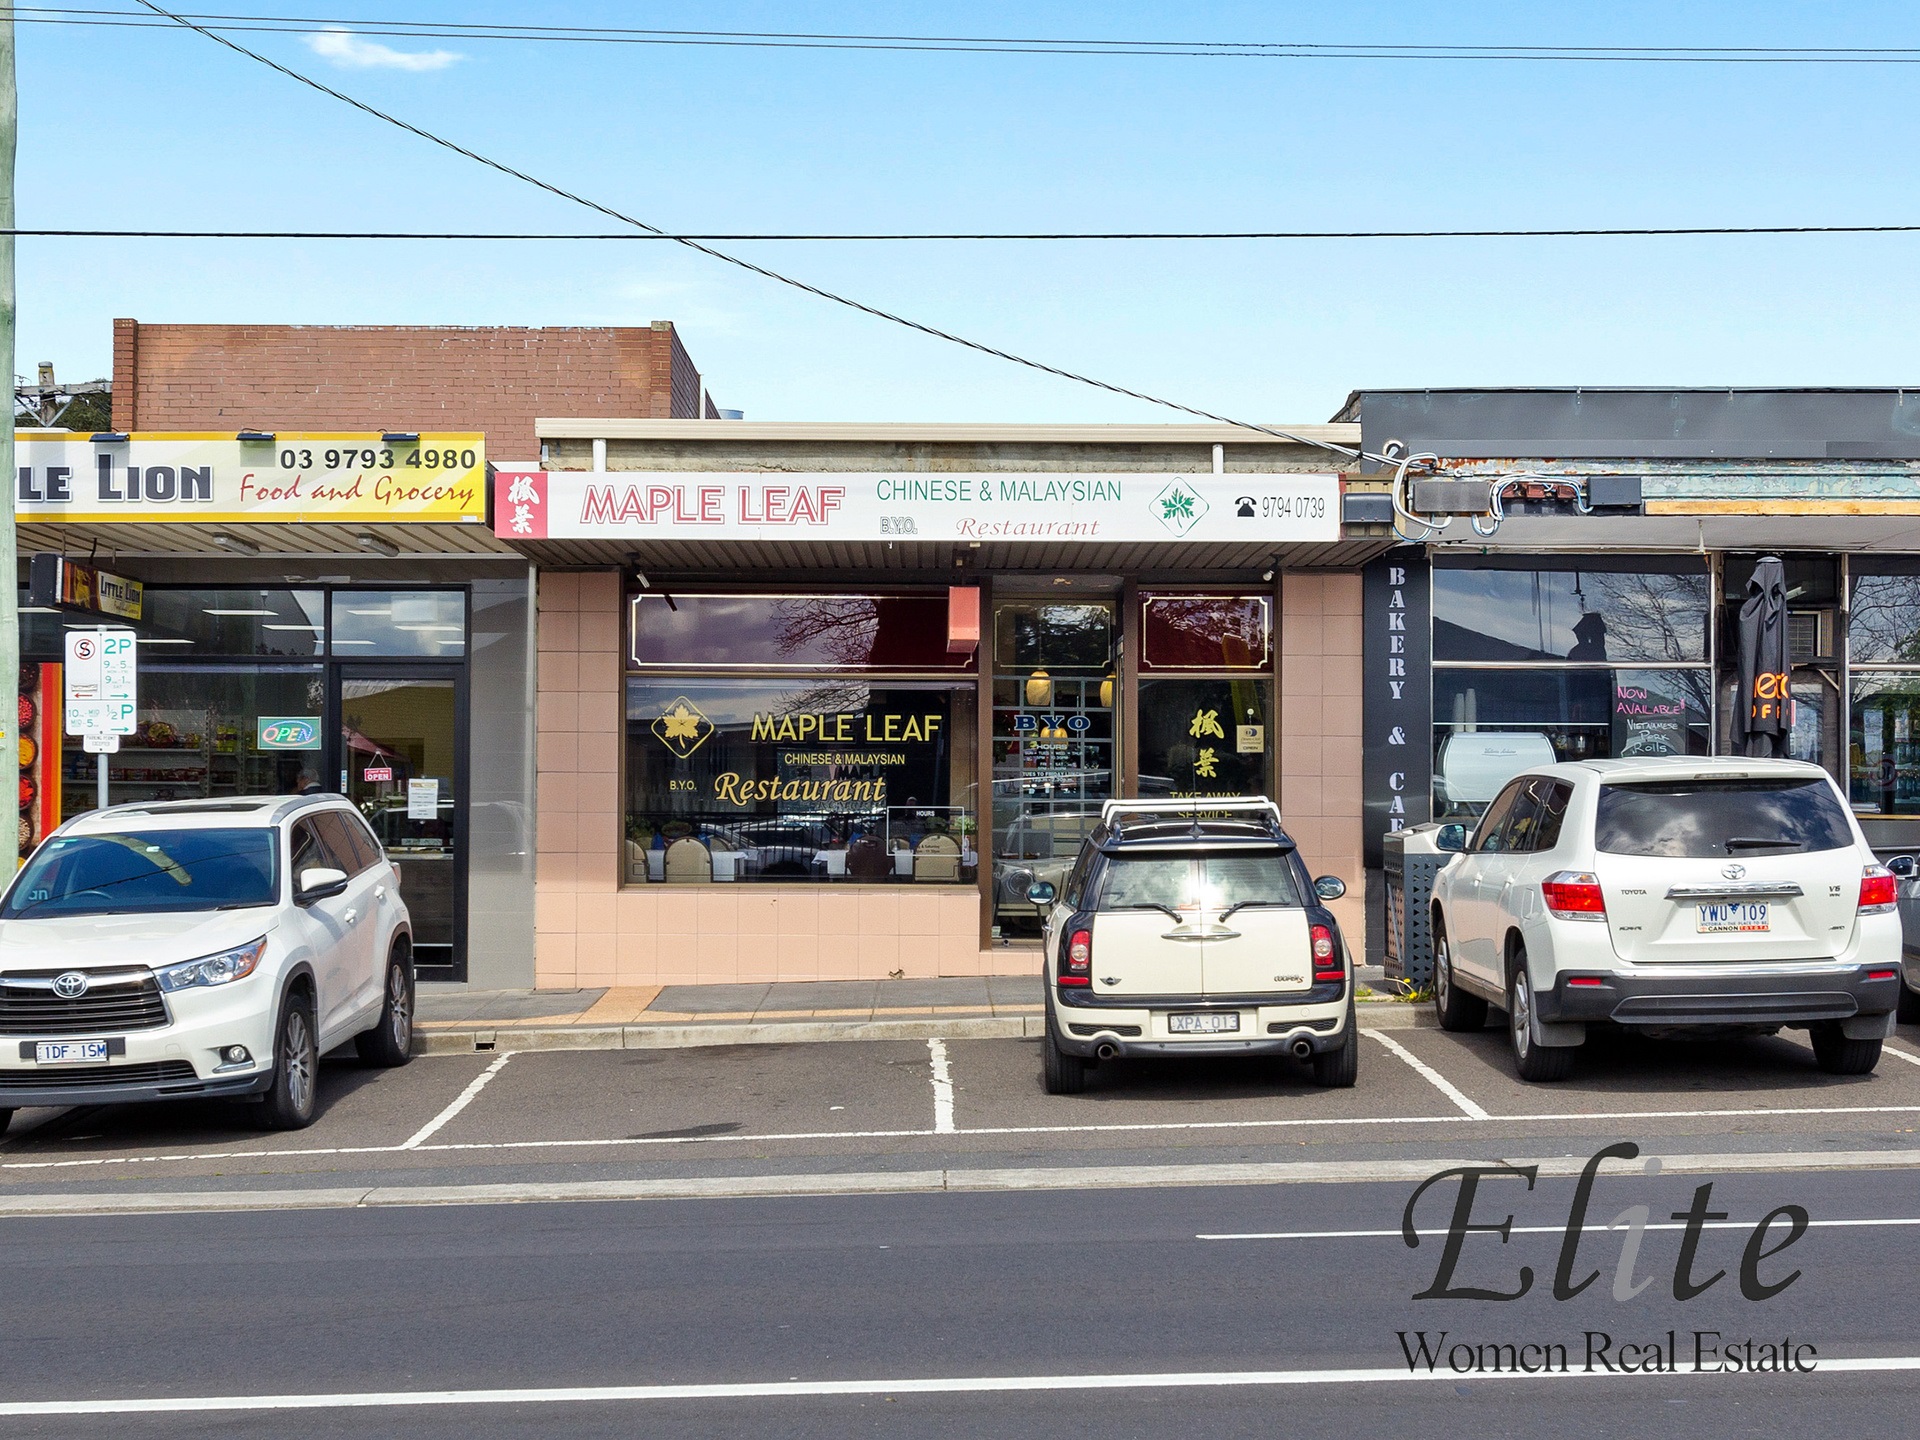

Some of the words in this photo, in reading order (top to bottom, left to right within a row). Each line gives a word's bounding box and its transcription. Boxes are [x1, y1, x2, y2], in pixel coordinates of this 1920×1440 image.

[280, 449, 313, 469] 03
[324, 449, 394, 469] 9793
[406, 449, 476, 469] 4980
[97, 453, 214, 503] LION
[240, 474, 302, 502] Food
[311, 474, 363, 501] and
[374, 475, 474, 510] Grocery
[876, 479, 972, 501] CHINESE
[979, 480, 993, 501] &
[1000, 480, 1122, 501] MALAYSIAN
[580, 484, 726, 525] MAPLE
[738, 485, 846, 526] LEAF
[1262, 496, 1292, 518] 9794
[1295, 496, 1325, 518] 0739
[956, 517, 1100, 538] Restaurant
[100, 575, 123, 600] LITTLE
[125, 582, 141, 603] LION
[1388, 567, 1406, 700] BAKERY
[104, 638, 132, 654] 2P
[1617, 686, 1648, 699] NOW
[750, 714, 854, 742] MAPLE
[866, 714, 942, 742] LEAF
[1014, 714, 1091, 731] BYO
[1626, 718, 1678, 730] VIETNAMESE
[262, 726, 312, 742] OPEN
[1388, 726, 1406, 745] &
[784, 753, 832, 765] CHINESE
[834, 754, 842, 765] &
[844, 754, 906, 765] MALAYSIAN
[670, 780, 697, 790] B.Y.O.
[714, 772, 886, 806] Restaurant
[1700, 905, 1727, 922] YWU
[1742, 905, 1766, 921] 109
